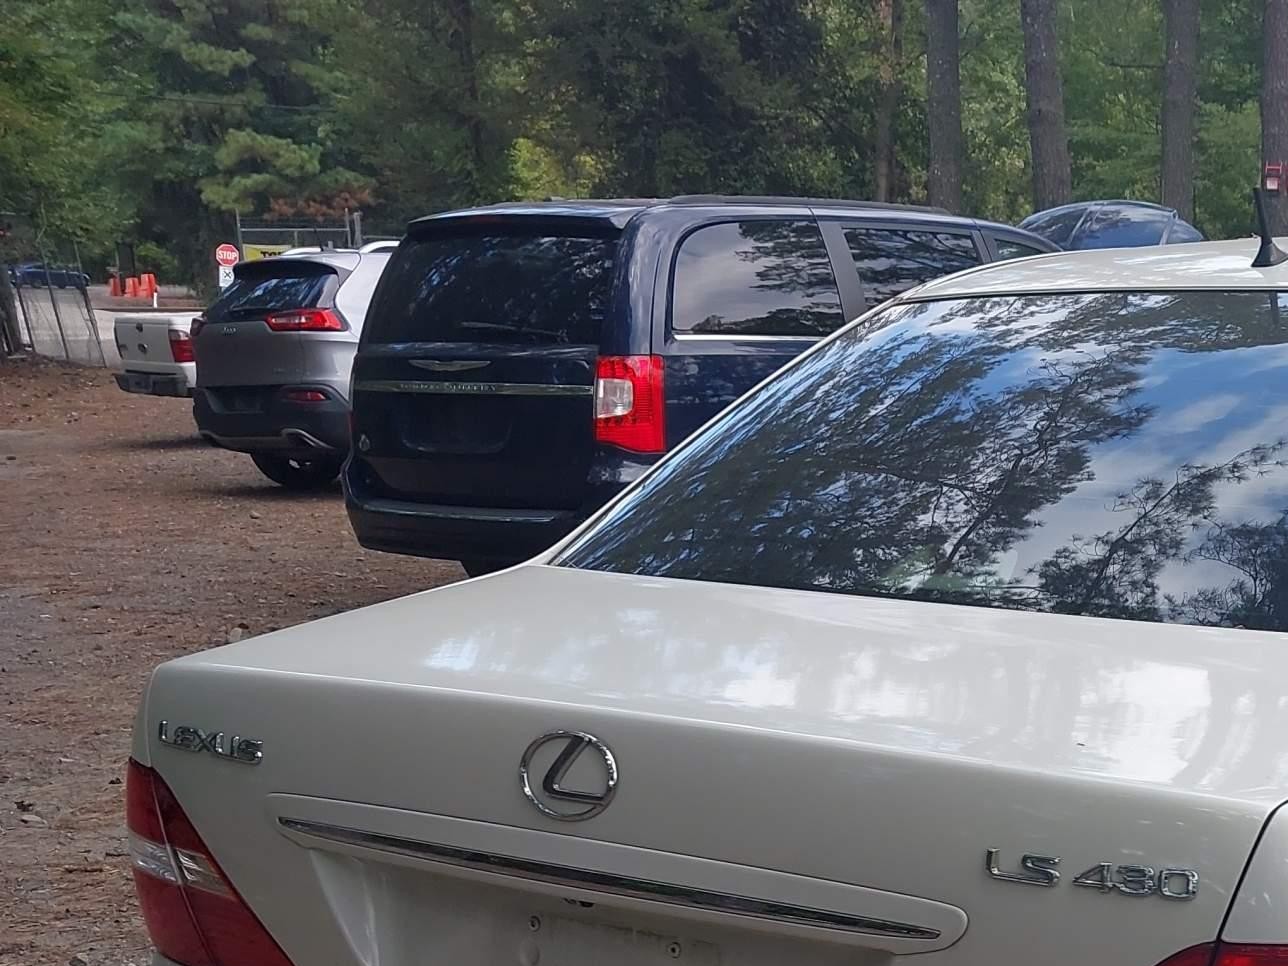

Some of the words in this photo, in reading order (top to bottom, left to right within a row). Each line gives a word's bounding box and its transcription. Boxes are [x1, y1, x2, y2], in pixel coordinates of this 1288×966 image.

[218, 251, 237, 260] STOP
[159, 720, 263, 765] LEXUS
[985, 848, 1061, 887] LS
[1072, 861, 1199, 900] 430
